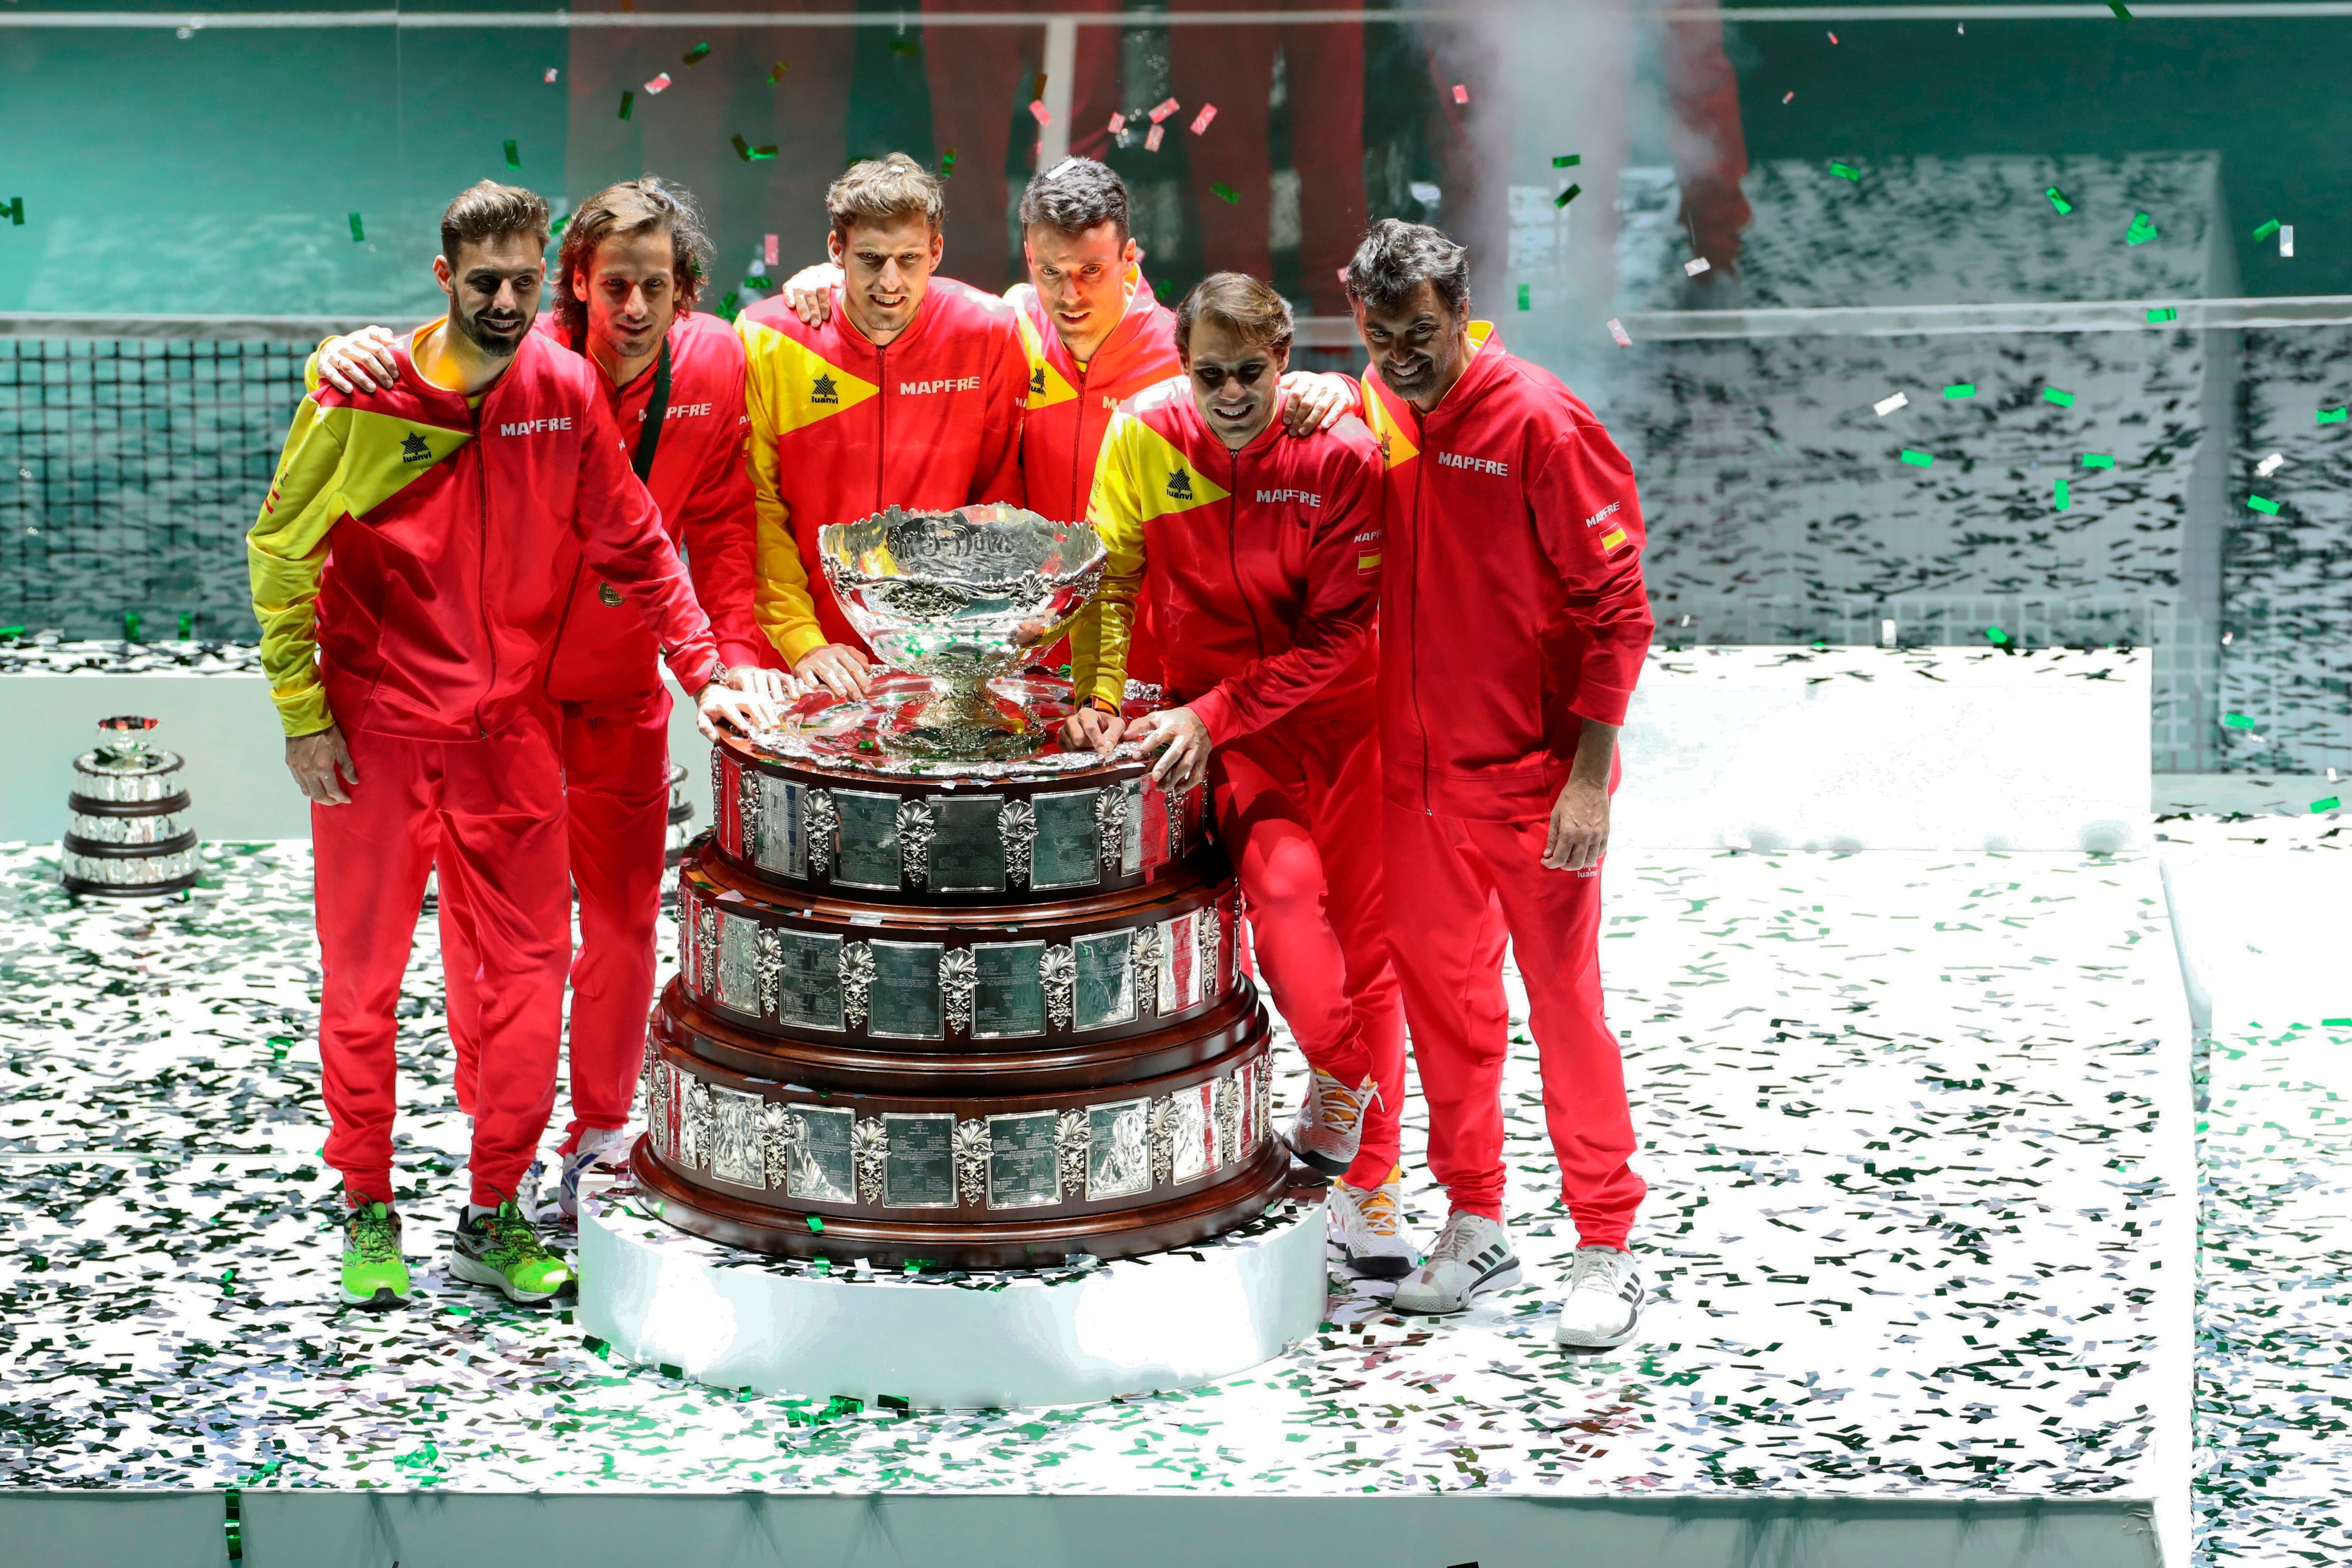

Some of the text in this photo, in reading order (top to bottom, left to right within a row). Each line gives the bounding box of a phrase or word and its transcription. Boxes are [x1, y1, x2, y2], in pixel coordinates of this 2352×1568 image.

[900, 376, 980, 395] MAPFRE
[811, 396, 838, 404] luanvi
[638, 403, 712, 421] MPFRE
[501, 417, 572, 437] MAPFRE
[403, 451, 432, 463] luanvi
[1438, 451, 1508, 477] MAPFRE
[1167, 488, 1193, 501] luanvi
[1256, 489, 1321, 508] MAPFRE
[1586, 501, 1621, 528] MAPFRE
[1354, 528, 1383, 544] MAPF
